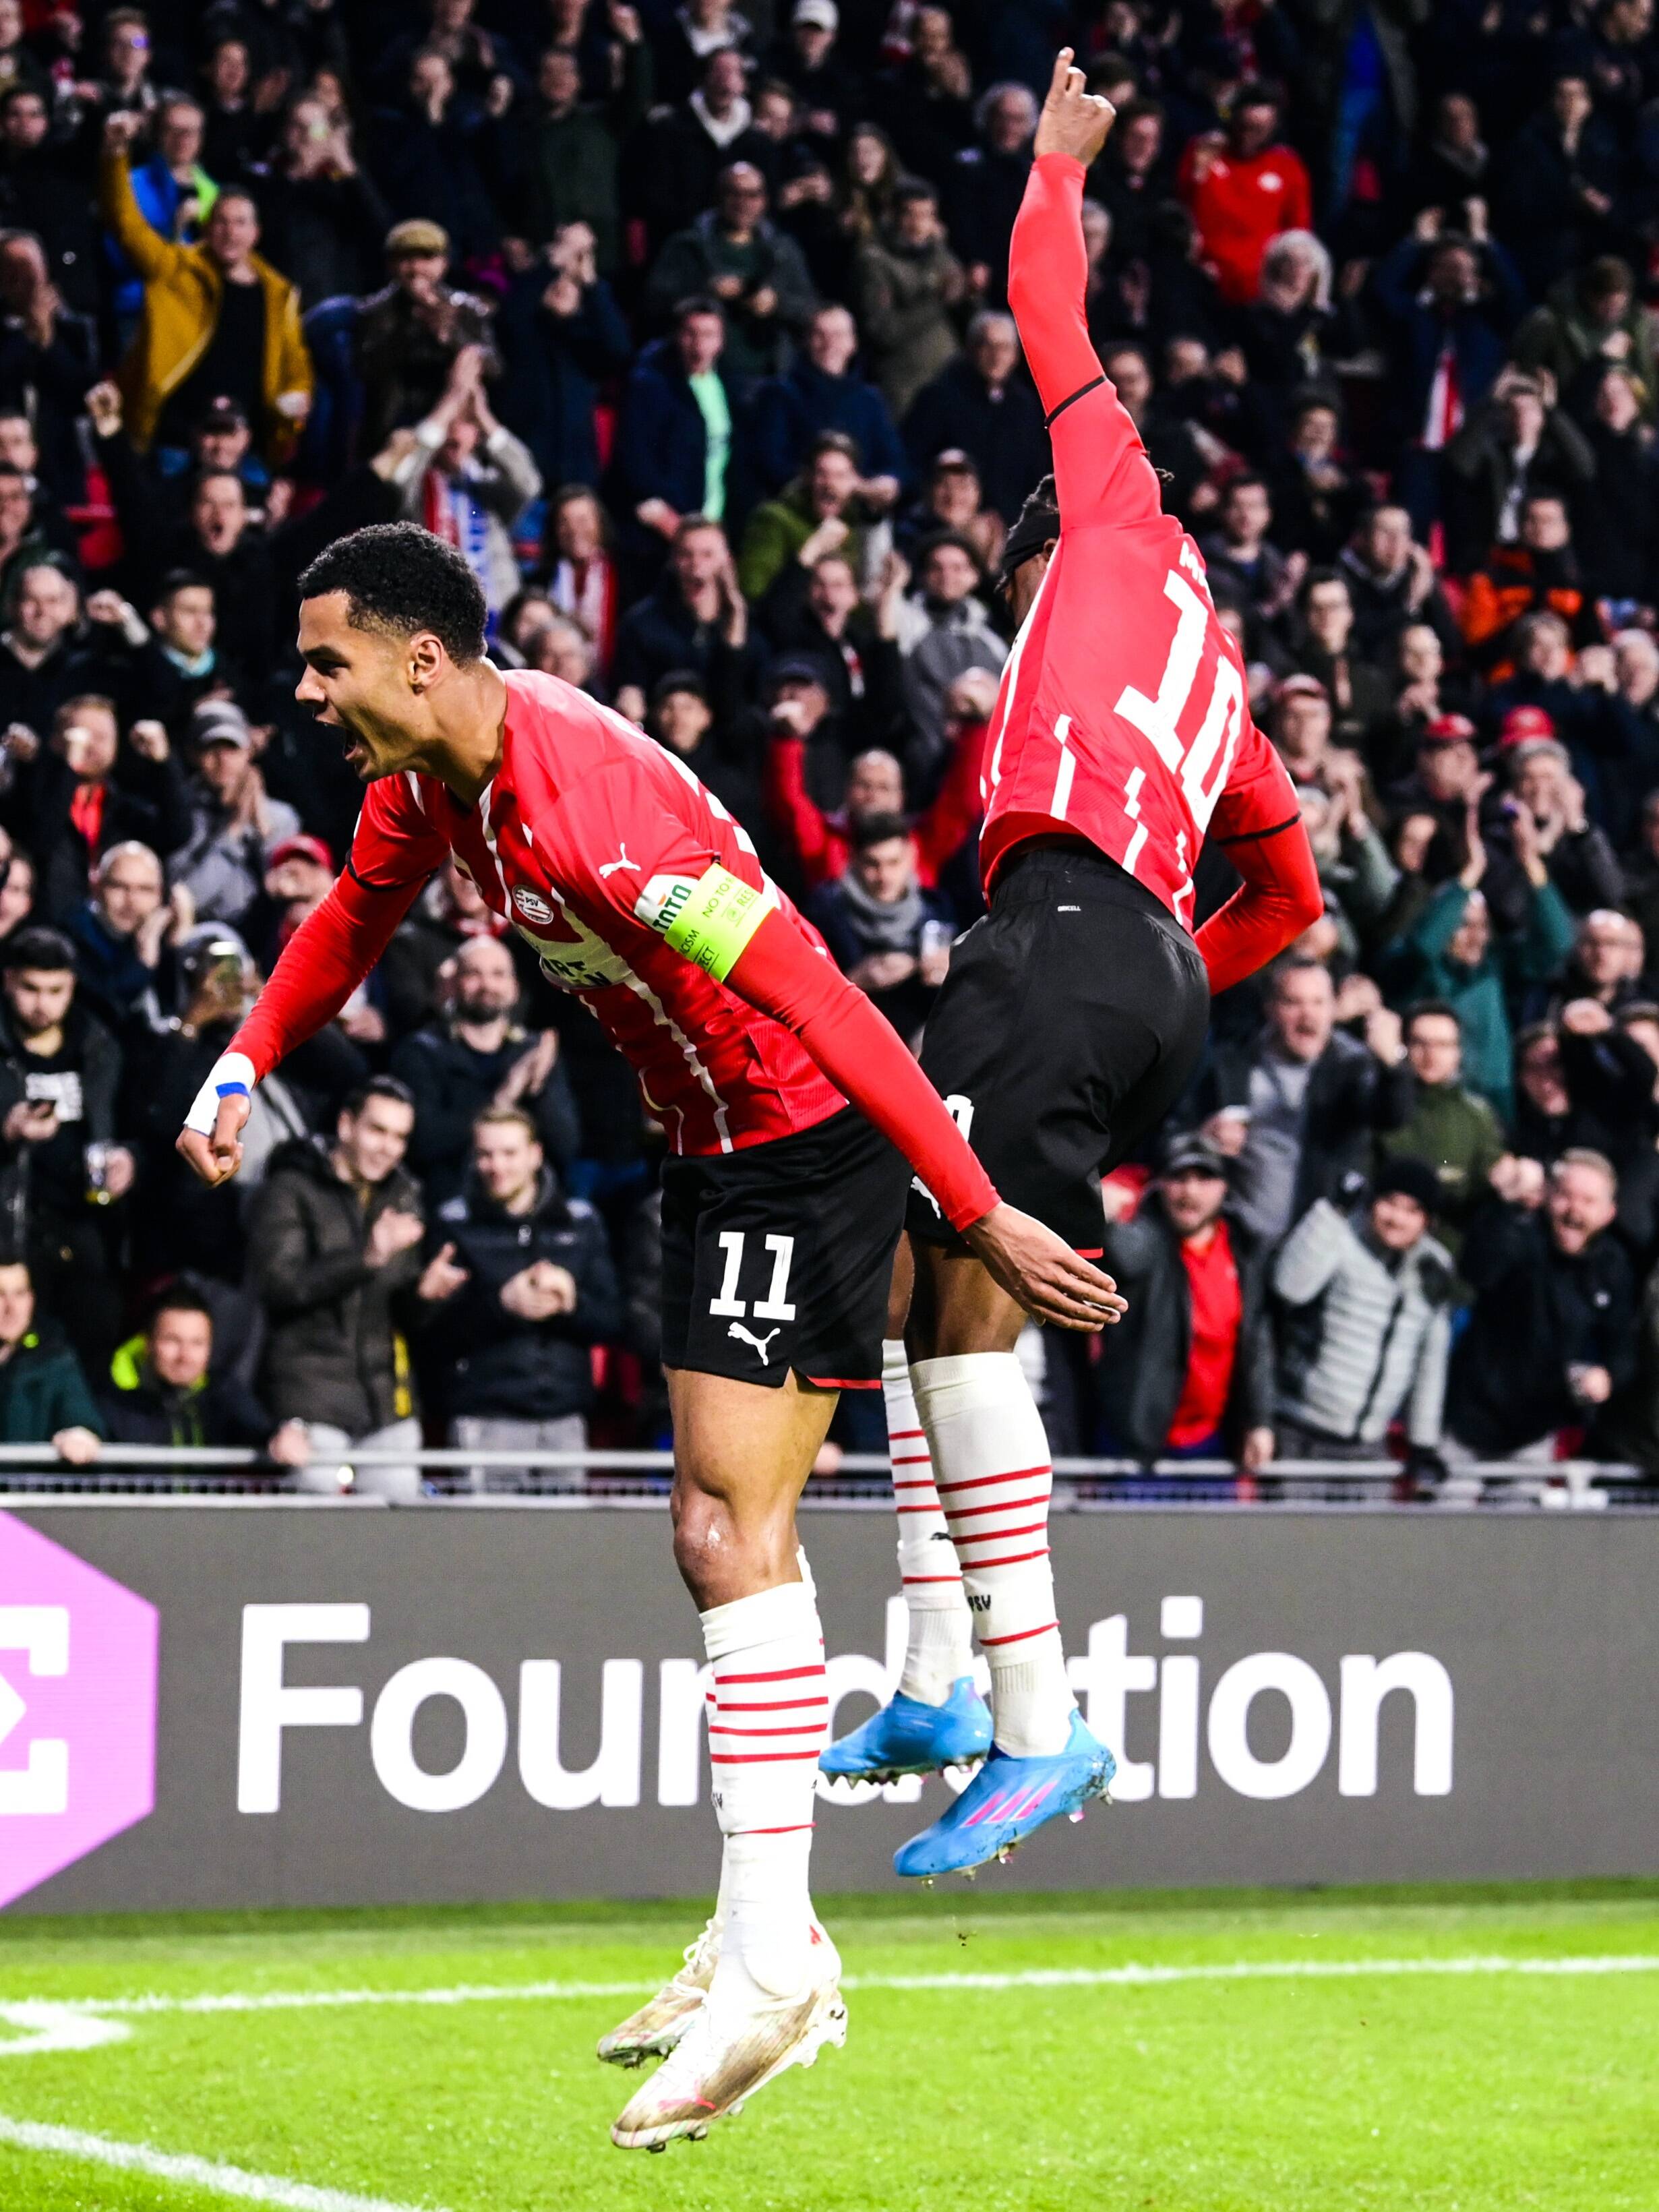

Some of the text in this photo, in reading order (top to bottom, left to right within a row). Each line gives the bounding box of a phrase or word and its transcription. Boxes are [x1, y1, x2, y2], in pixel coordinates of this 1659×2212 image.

[1113, 568, 1243, 835] 10
[652, 884, 692, 930] TOTO
[702, 883, 729, 918] NO TO
[736, 888, 755, 907] RES
[709, 1231, 796, 1321] 11
[237, 1595, 1454, 1814] Foundtion
